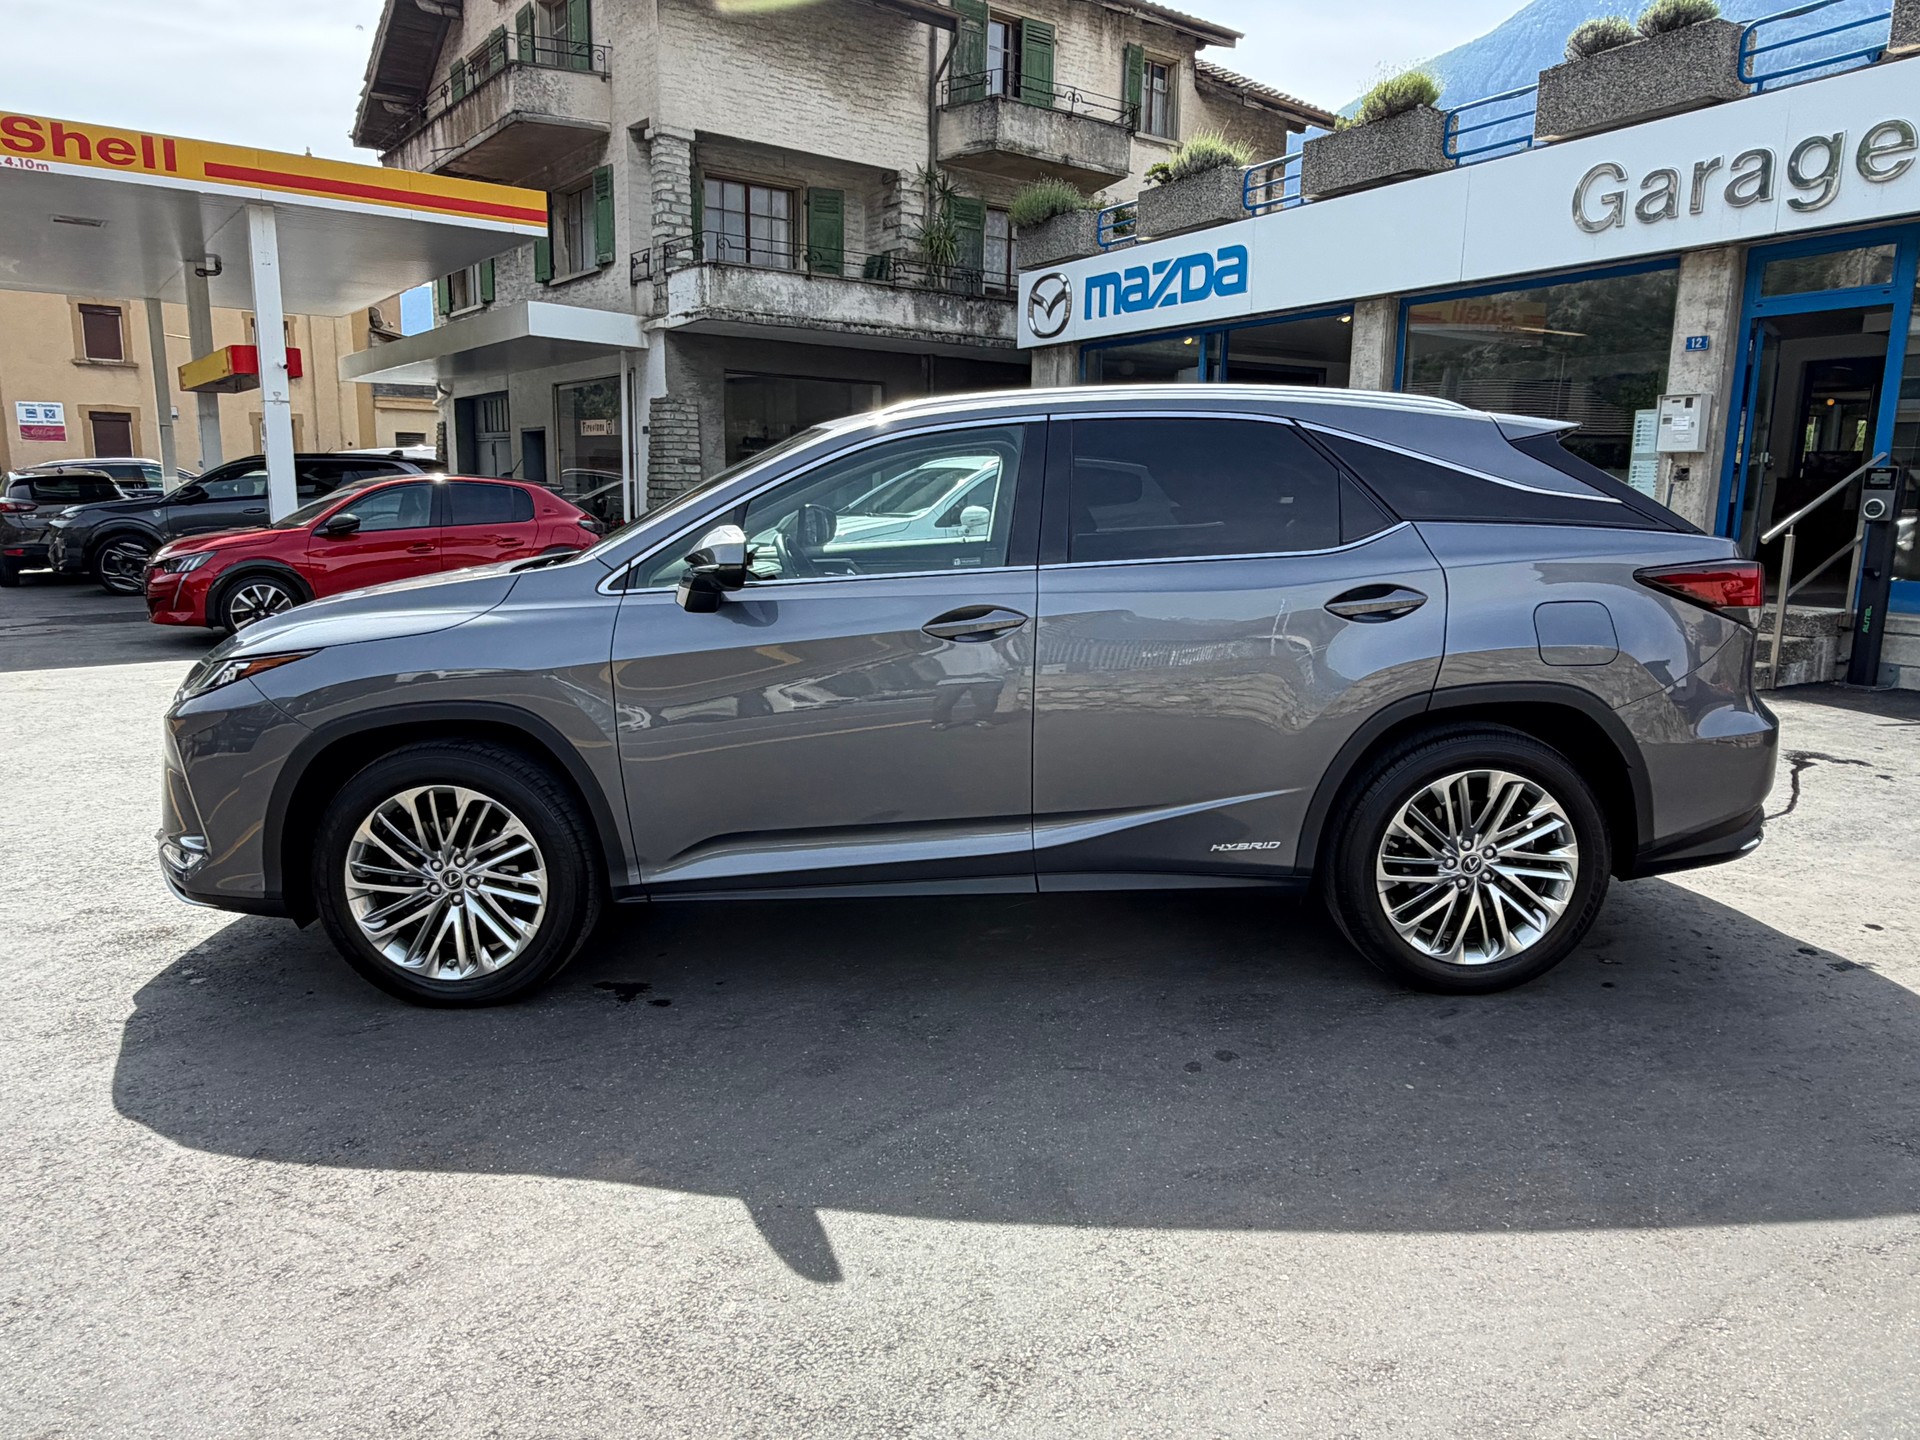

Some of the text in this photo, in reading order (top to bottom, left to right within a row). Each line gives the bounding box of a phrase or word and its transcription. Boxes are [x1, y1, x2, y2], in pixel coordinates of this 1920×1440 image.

[0, 115, 177, 172] Shell
[1571, 117, 1919, 233] Garage
[1691, 337, 1703, 349] 12
[1209, 841, 1281, 852] HYBRID
